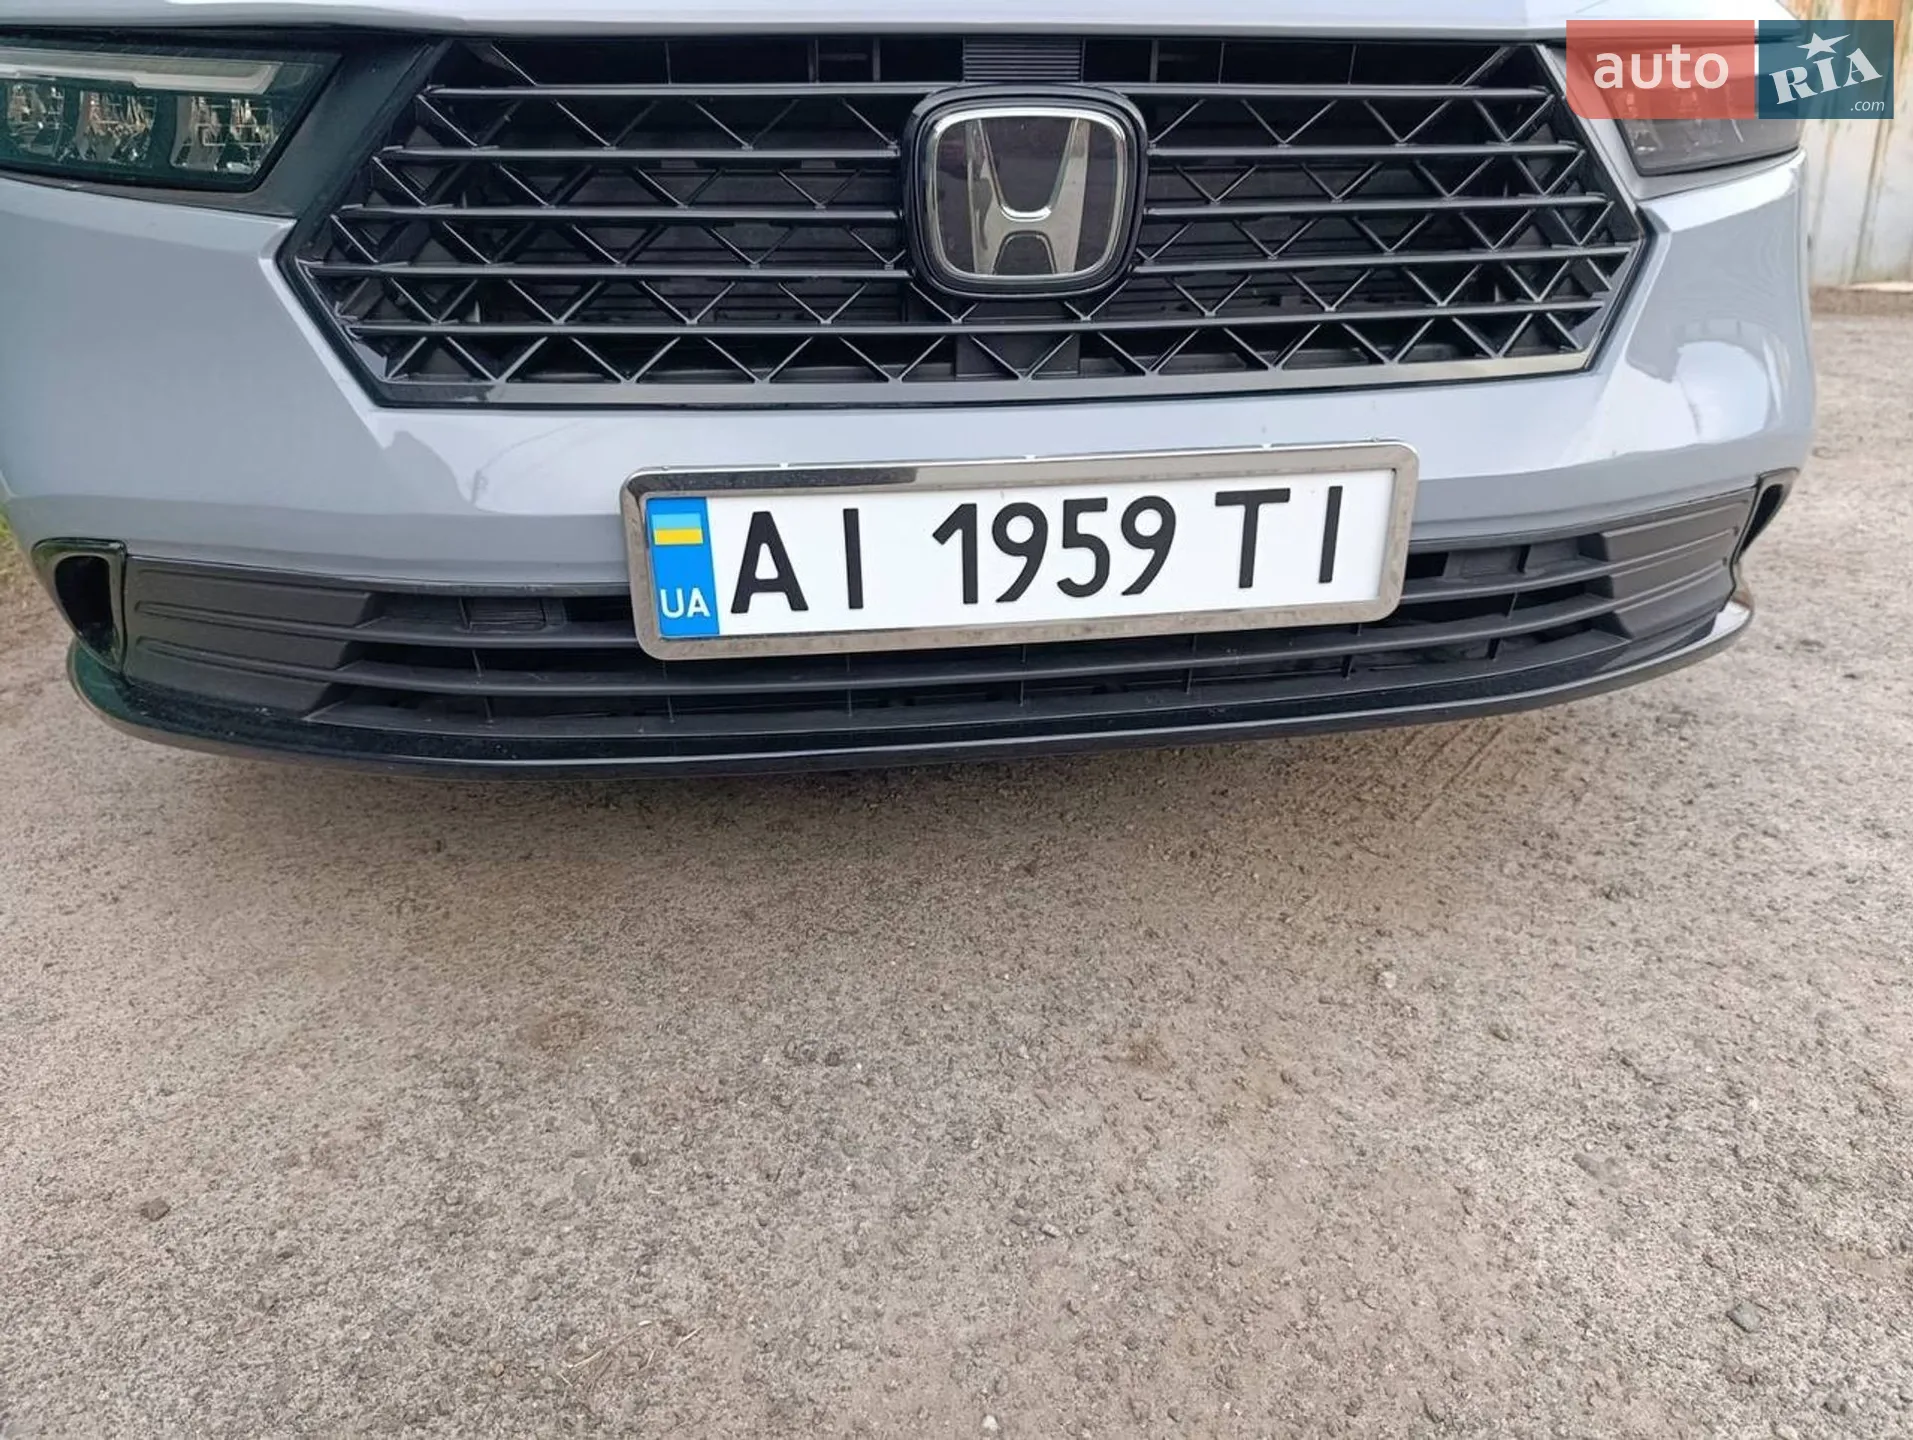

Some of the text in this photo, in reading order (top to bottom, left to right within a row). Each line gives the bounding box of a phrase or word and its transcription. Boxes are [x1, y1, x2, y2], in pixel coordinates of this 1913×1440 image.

[731, 485, 1344, 614] AI 1959 TI
[660, 588, 710, 619] UA
